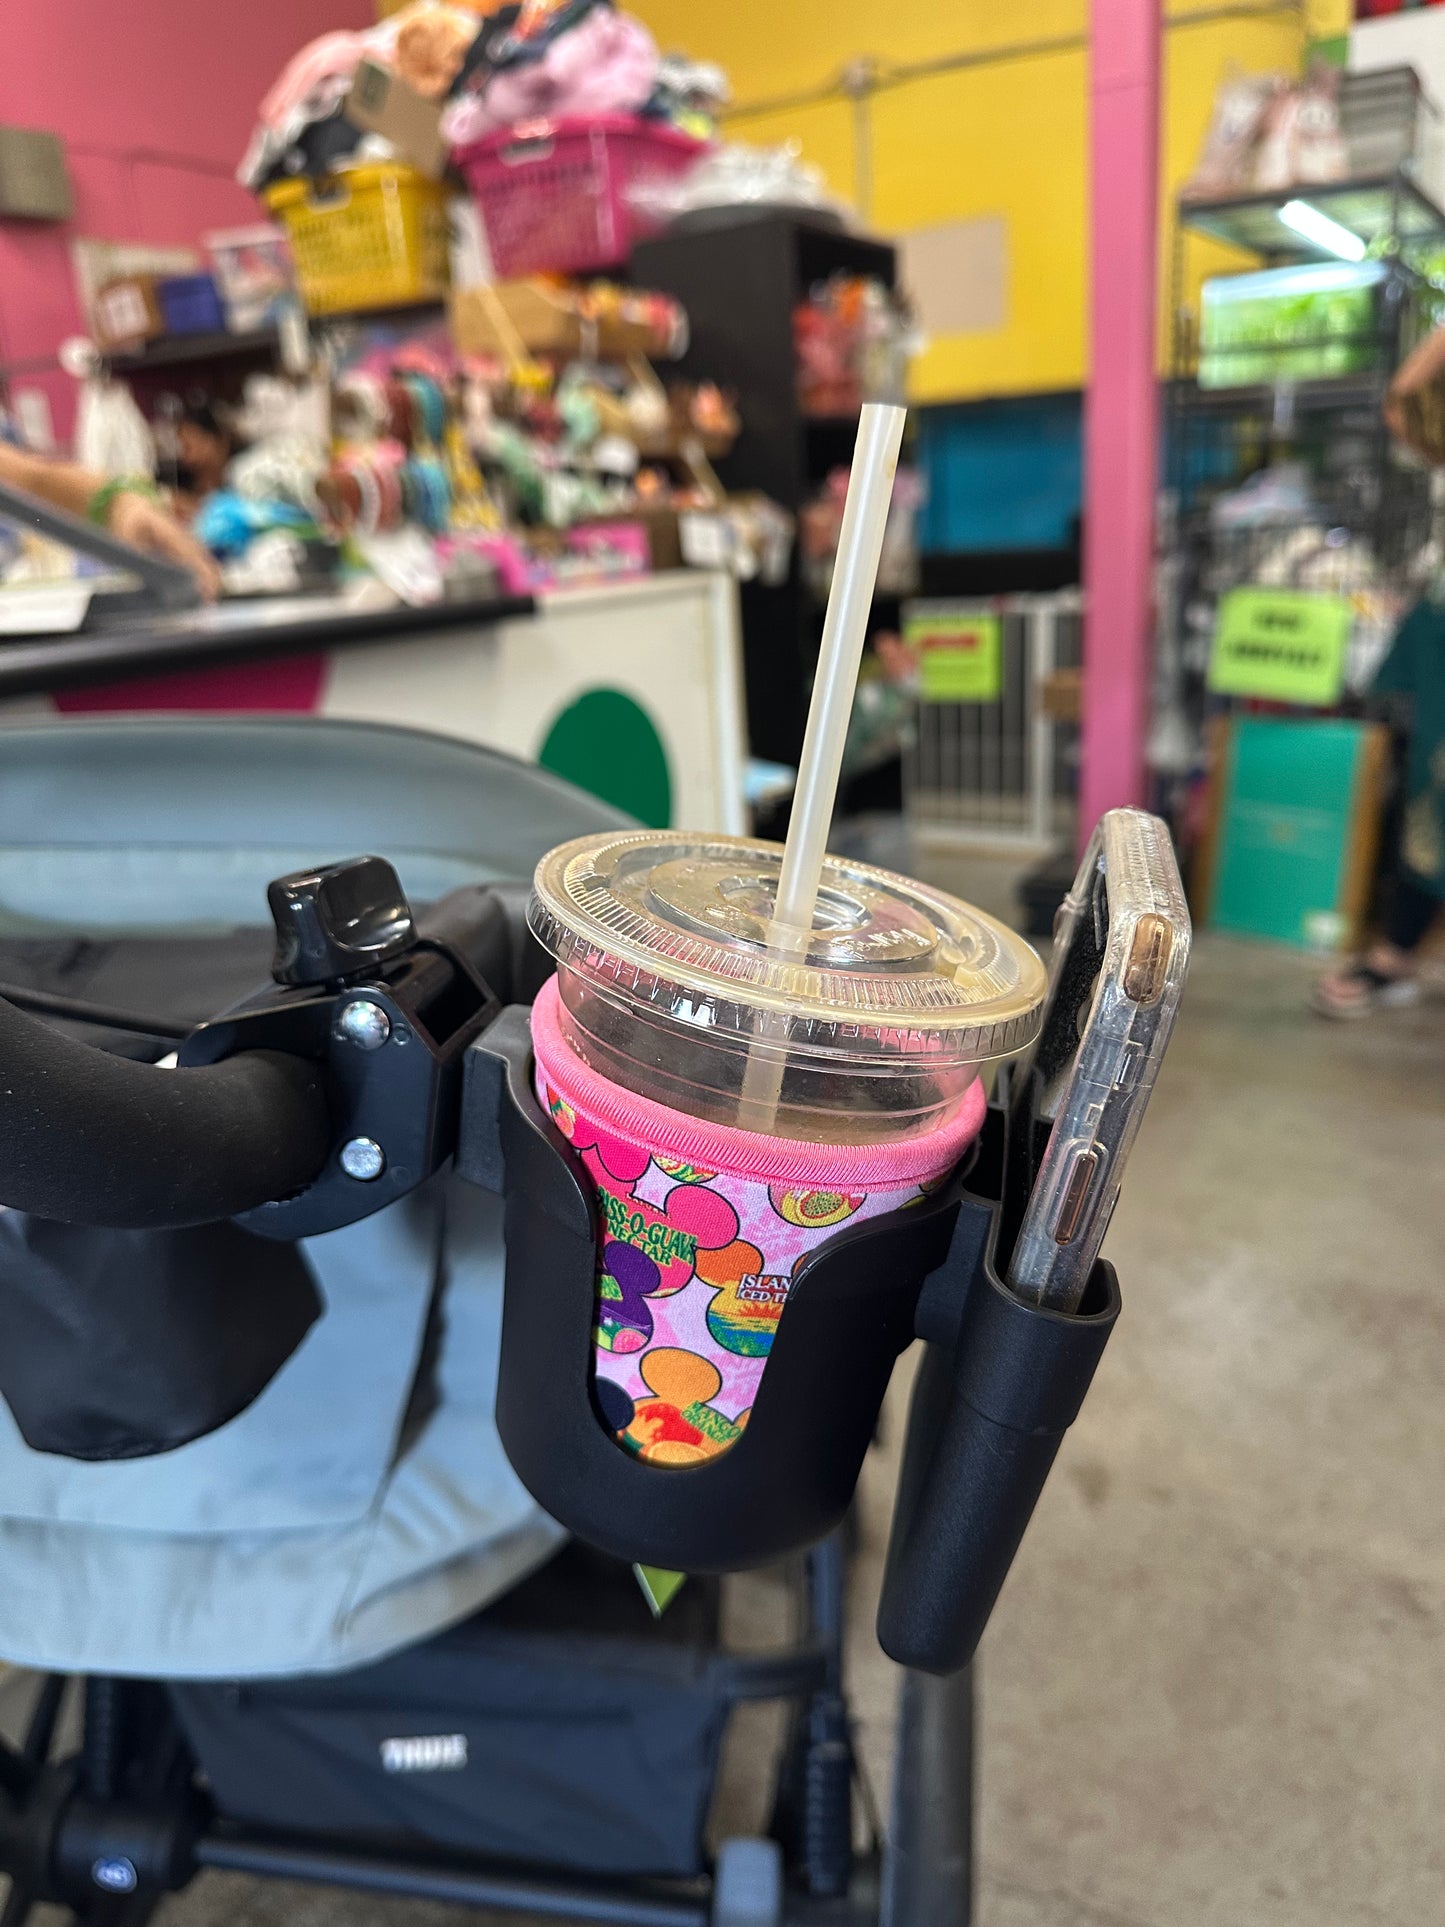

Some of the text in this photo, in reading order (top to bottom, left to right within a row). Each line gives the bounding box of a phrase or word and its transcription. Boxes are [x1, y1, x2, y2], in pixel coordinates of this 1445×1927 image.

[608, 1220, 672, 1267] NECTAR
[738, 1273, 793, 1292] ISLAN
[681, 1409, 731, 1443] ORANGE
[687, 1399, 743, 1440] MANGO
